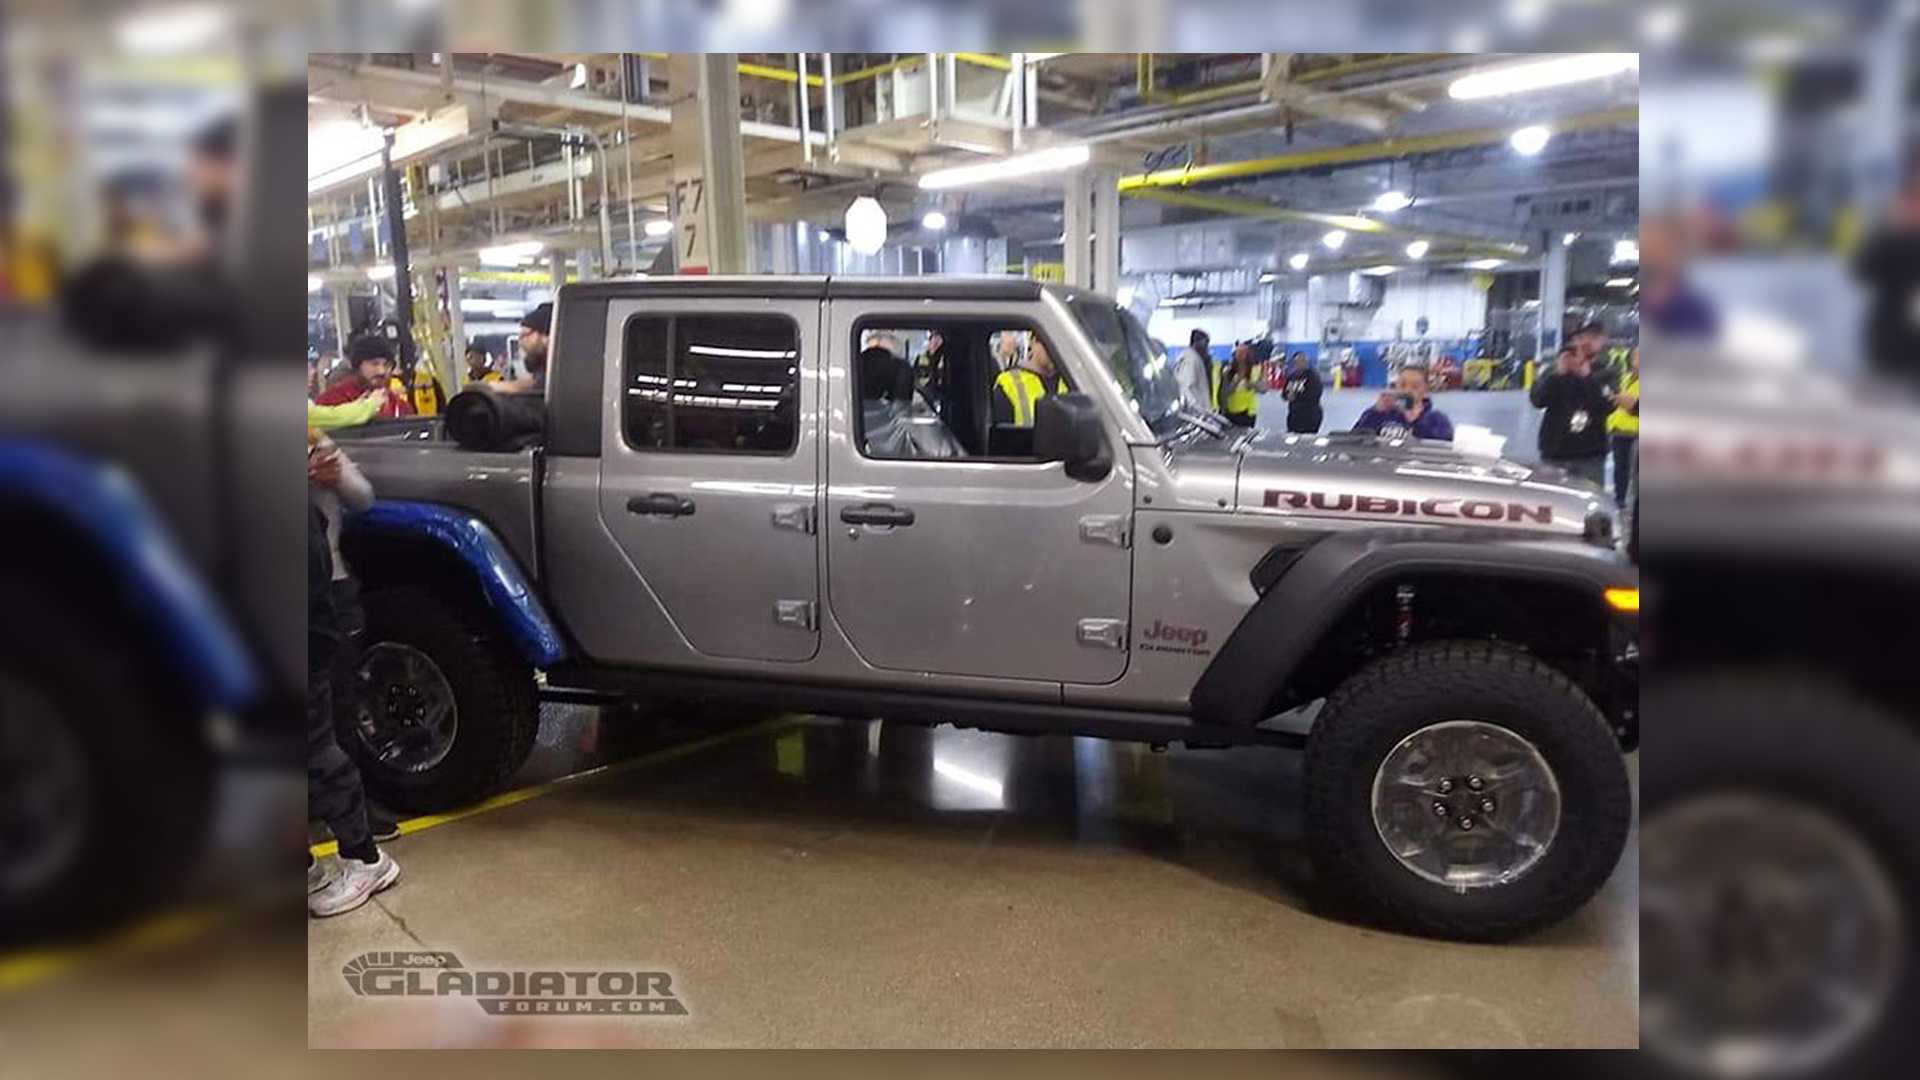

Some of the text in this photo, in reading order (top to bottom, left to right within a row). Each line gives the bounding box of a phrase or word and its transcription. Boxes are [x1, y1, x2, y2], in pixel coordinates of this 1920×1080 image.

[675, 178, 704, 215] F7
[684, 224, 696, 258] 7
[1262, 489, 1553, 524] RUBICON
[1143, 619, 1208, 647] Jeep
